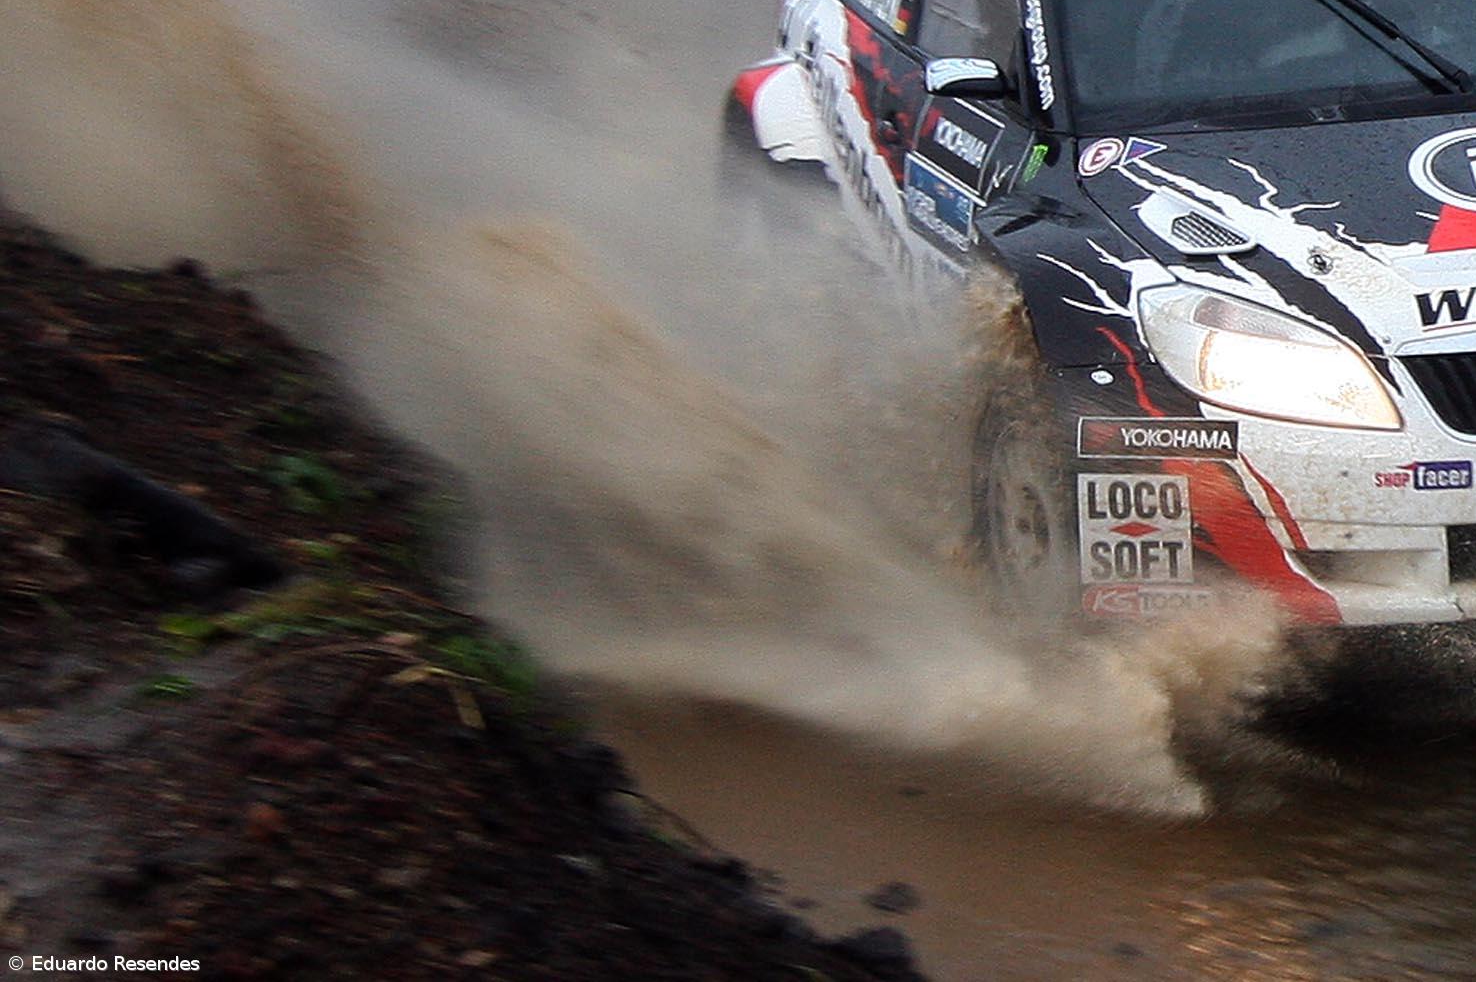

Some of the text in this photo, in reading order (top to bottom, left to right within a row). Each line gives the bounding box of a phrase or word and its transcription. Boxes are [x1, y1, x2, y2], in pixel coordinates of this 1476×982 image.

[1121, 427, 1233, 450] YOKOHAMA
[1375, 464, 1470, 489] SHOP facer
[1087, 481, 1183, 520] LOCO
[1090, 540, 1184, 579] SOFT
